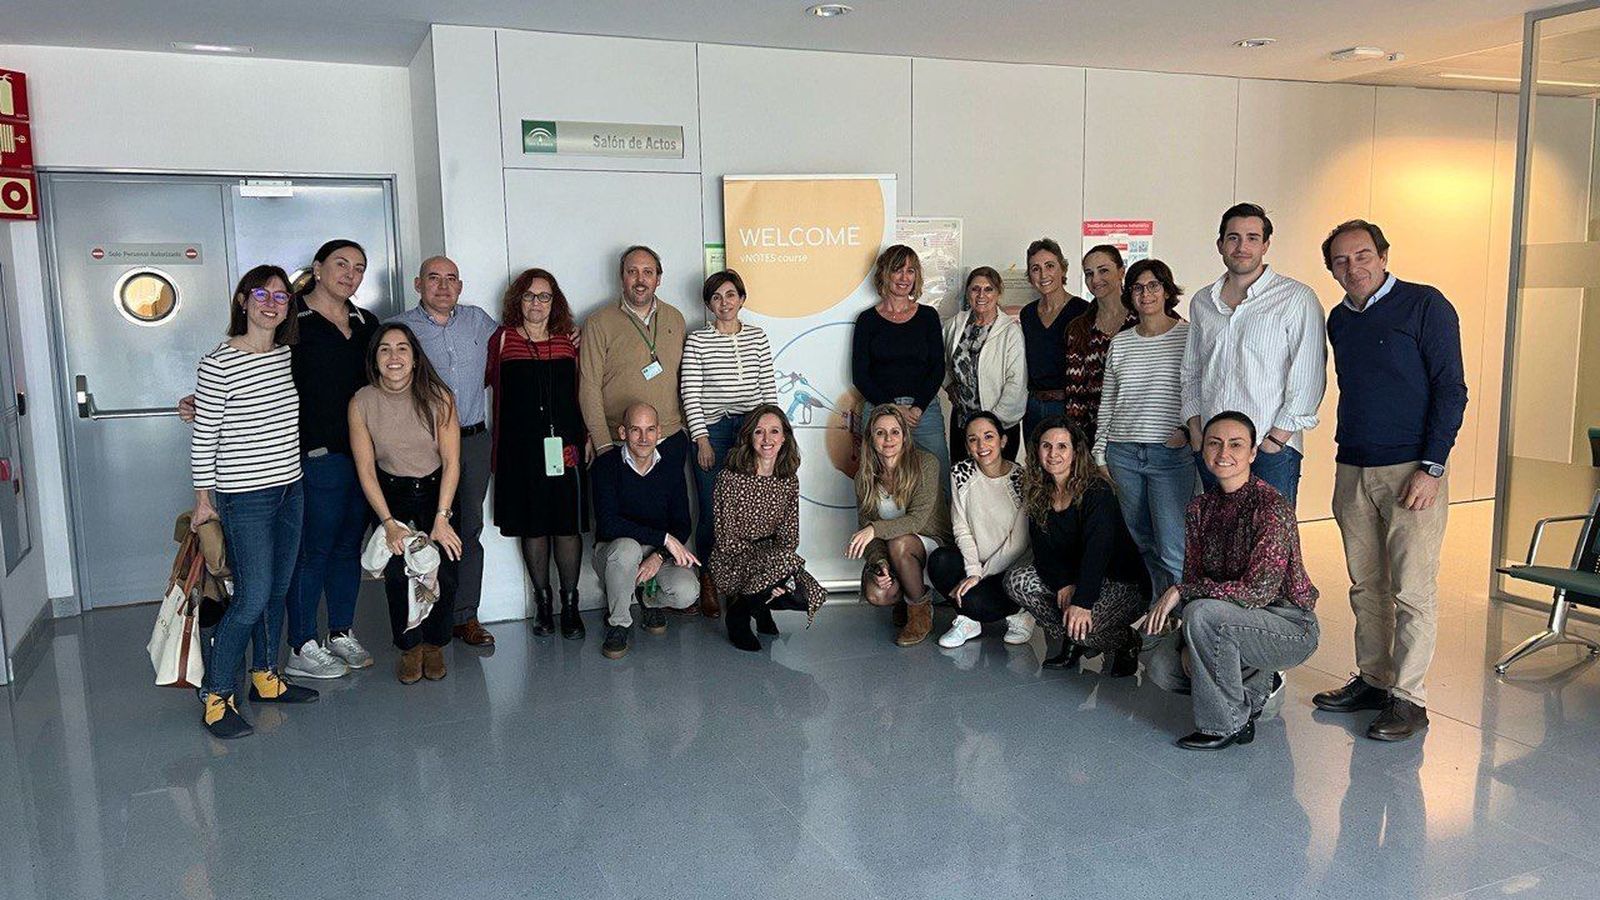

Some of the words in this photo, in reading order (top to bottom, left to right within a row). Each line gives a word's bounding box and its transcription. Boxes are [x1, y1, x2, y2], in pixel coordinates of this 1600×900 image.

[593, 134, 625, 149] Salón
[629, 137, 642, 149] de
[645, 136, 677, 151] Actos
[739, 226, 861, 247] WELCOME
[740, 252, 776, 263] vNOTES
[777, 254, 808, 263] course
